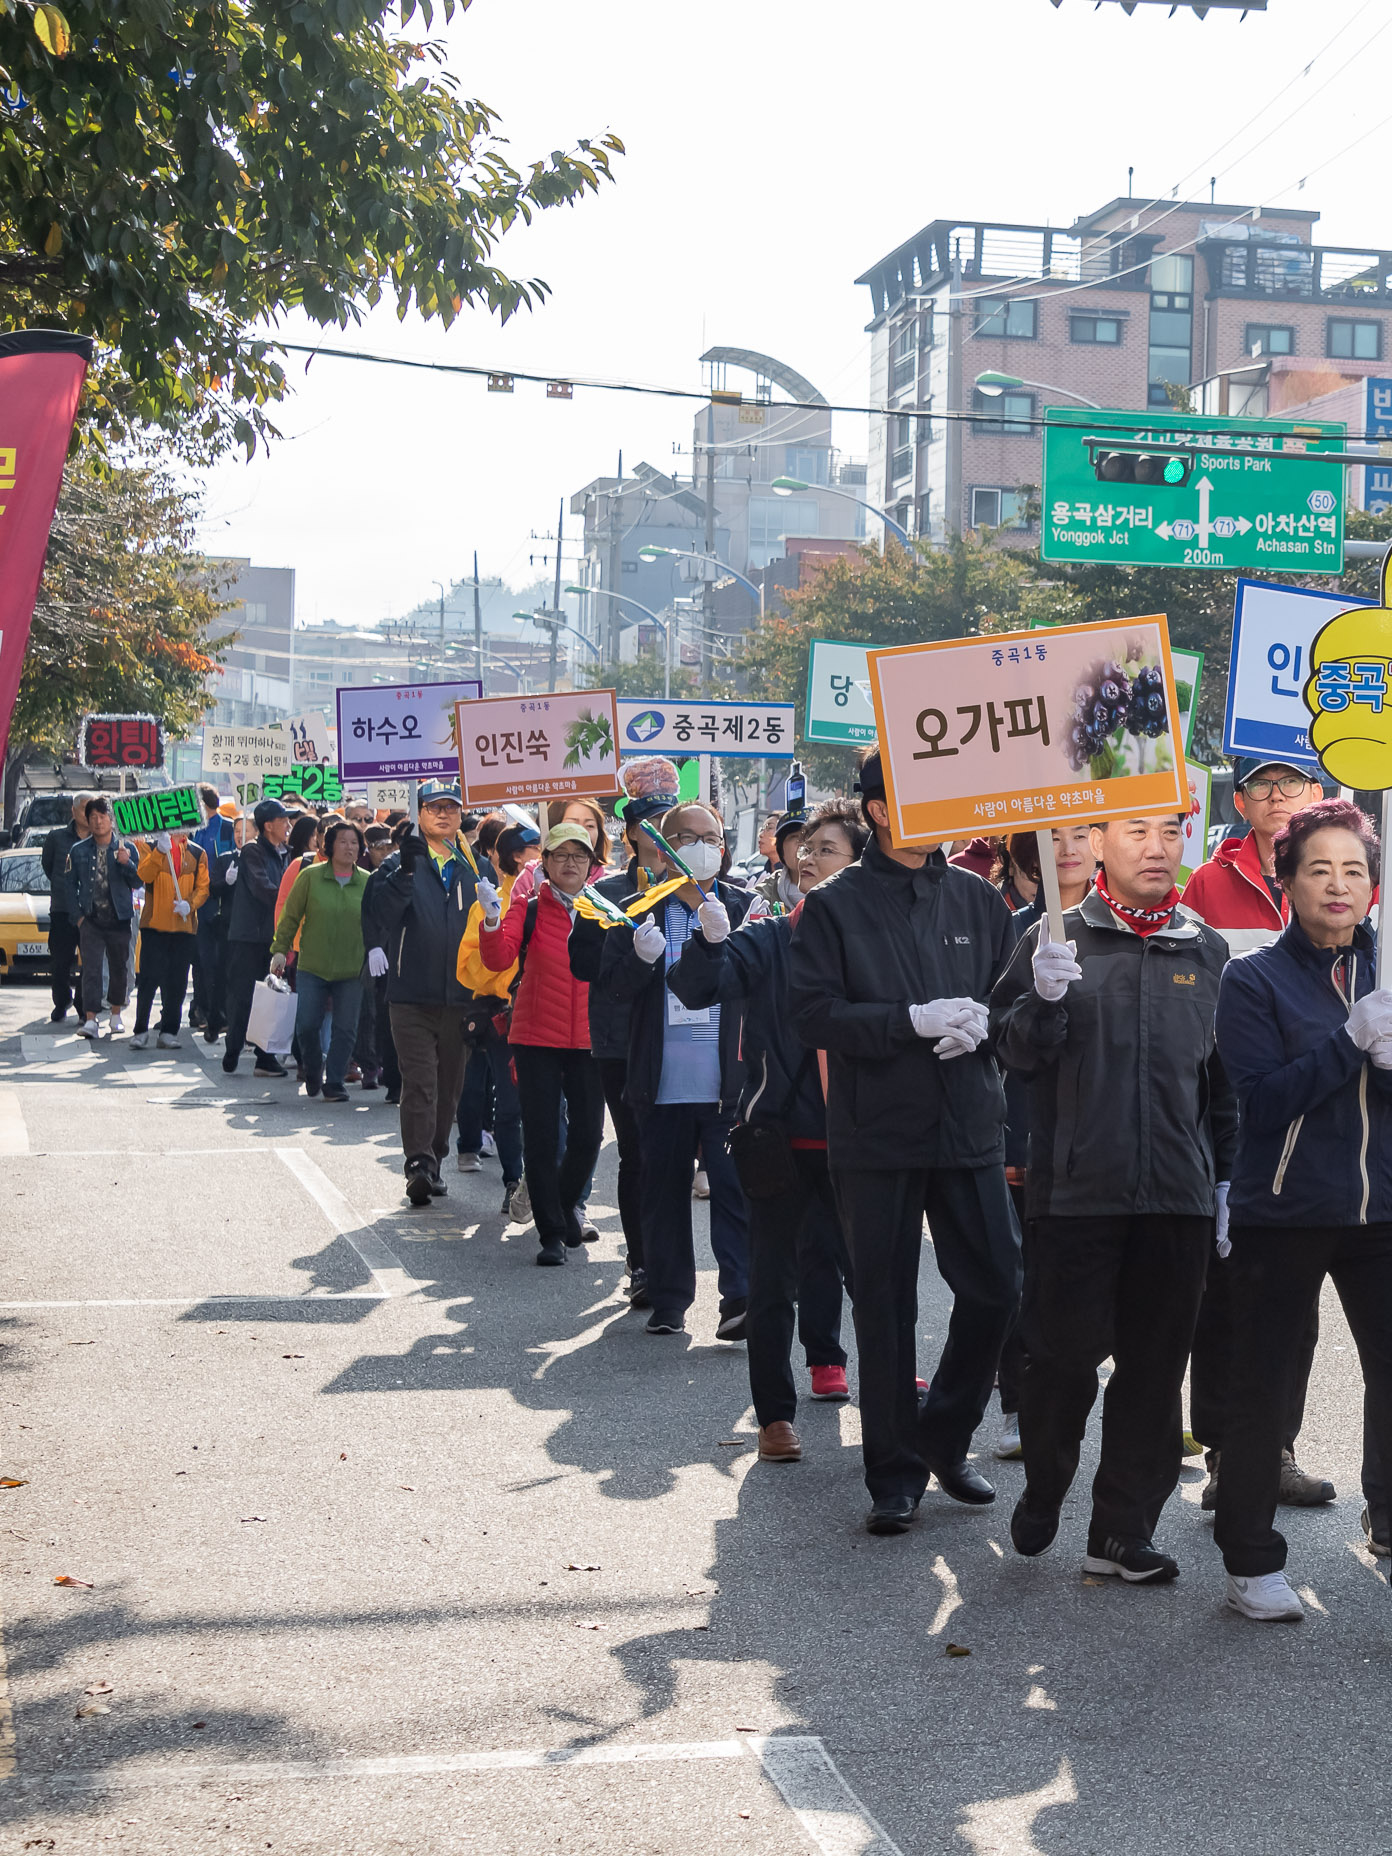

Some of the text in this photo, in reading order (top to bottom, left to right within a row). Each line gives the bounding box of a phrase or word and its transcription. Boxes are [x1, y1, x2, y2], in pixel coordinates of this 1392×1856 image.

[1201, 454, 1240, 471] Sports
[1244, 457, 1272, 472] Park
[1314, 495, 1330, 509] 50
[1051, 501, 1153, 529] 용곡삼거리
[1178, 523, 1190, 537] 71
[1217, 519, 1231, 534] 71
[1256, 513, 1336, 538] 아차산역
[1052, 528, 1129, 546] Yonggok Jct
[1257, 538, 1335, 555] Achasan Stn
[1184, 549, 1224, 564] 200m
[992, 644, 1048, 667] 중곡1동
[1267, 643, 1303, 698] 인
[830, 675, 854, 707] 당
[520, 701, 550, 713] 중곡1동
[352, 715, 422, 746] 하수오
[672, 714, 785, 744] 중곡제2동
[913, 696, 1051, 760] 오가피
[475, 729, 551, 767] 인진쑥
[379, 763, 396, 772] 사람이
[375, 787, 405, 805] 중곡2
[506, 784, 524, 795] 사람이
[525, 782, 550, 793] 아름다운
[113, 788, 202, 835] 에어로빅
[974, 787, 1105, 818] 사람이 아름다운 약초마을
[954, 936, 970, 945] K2
